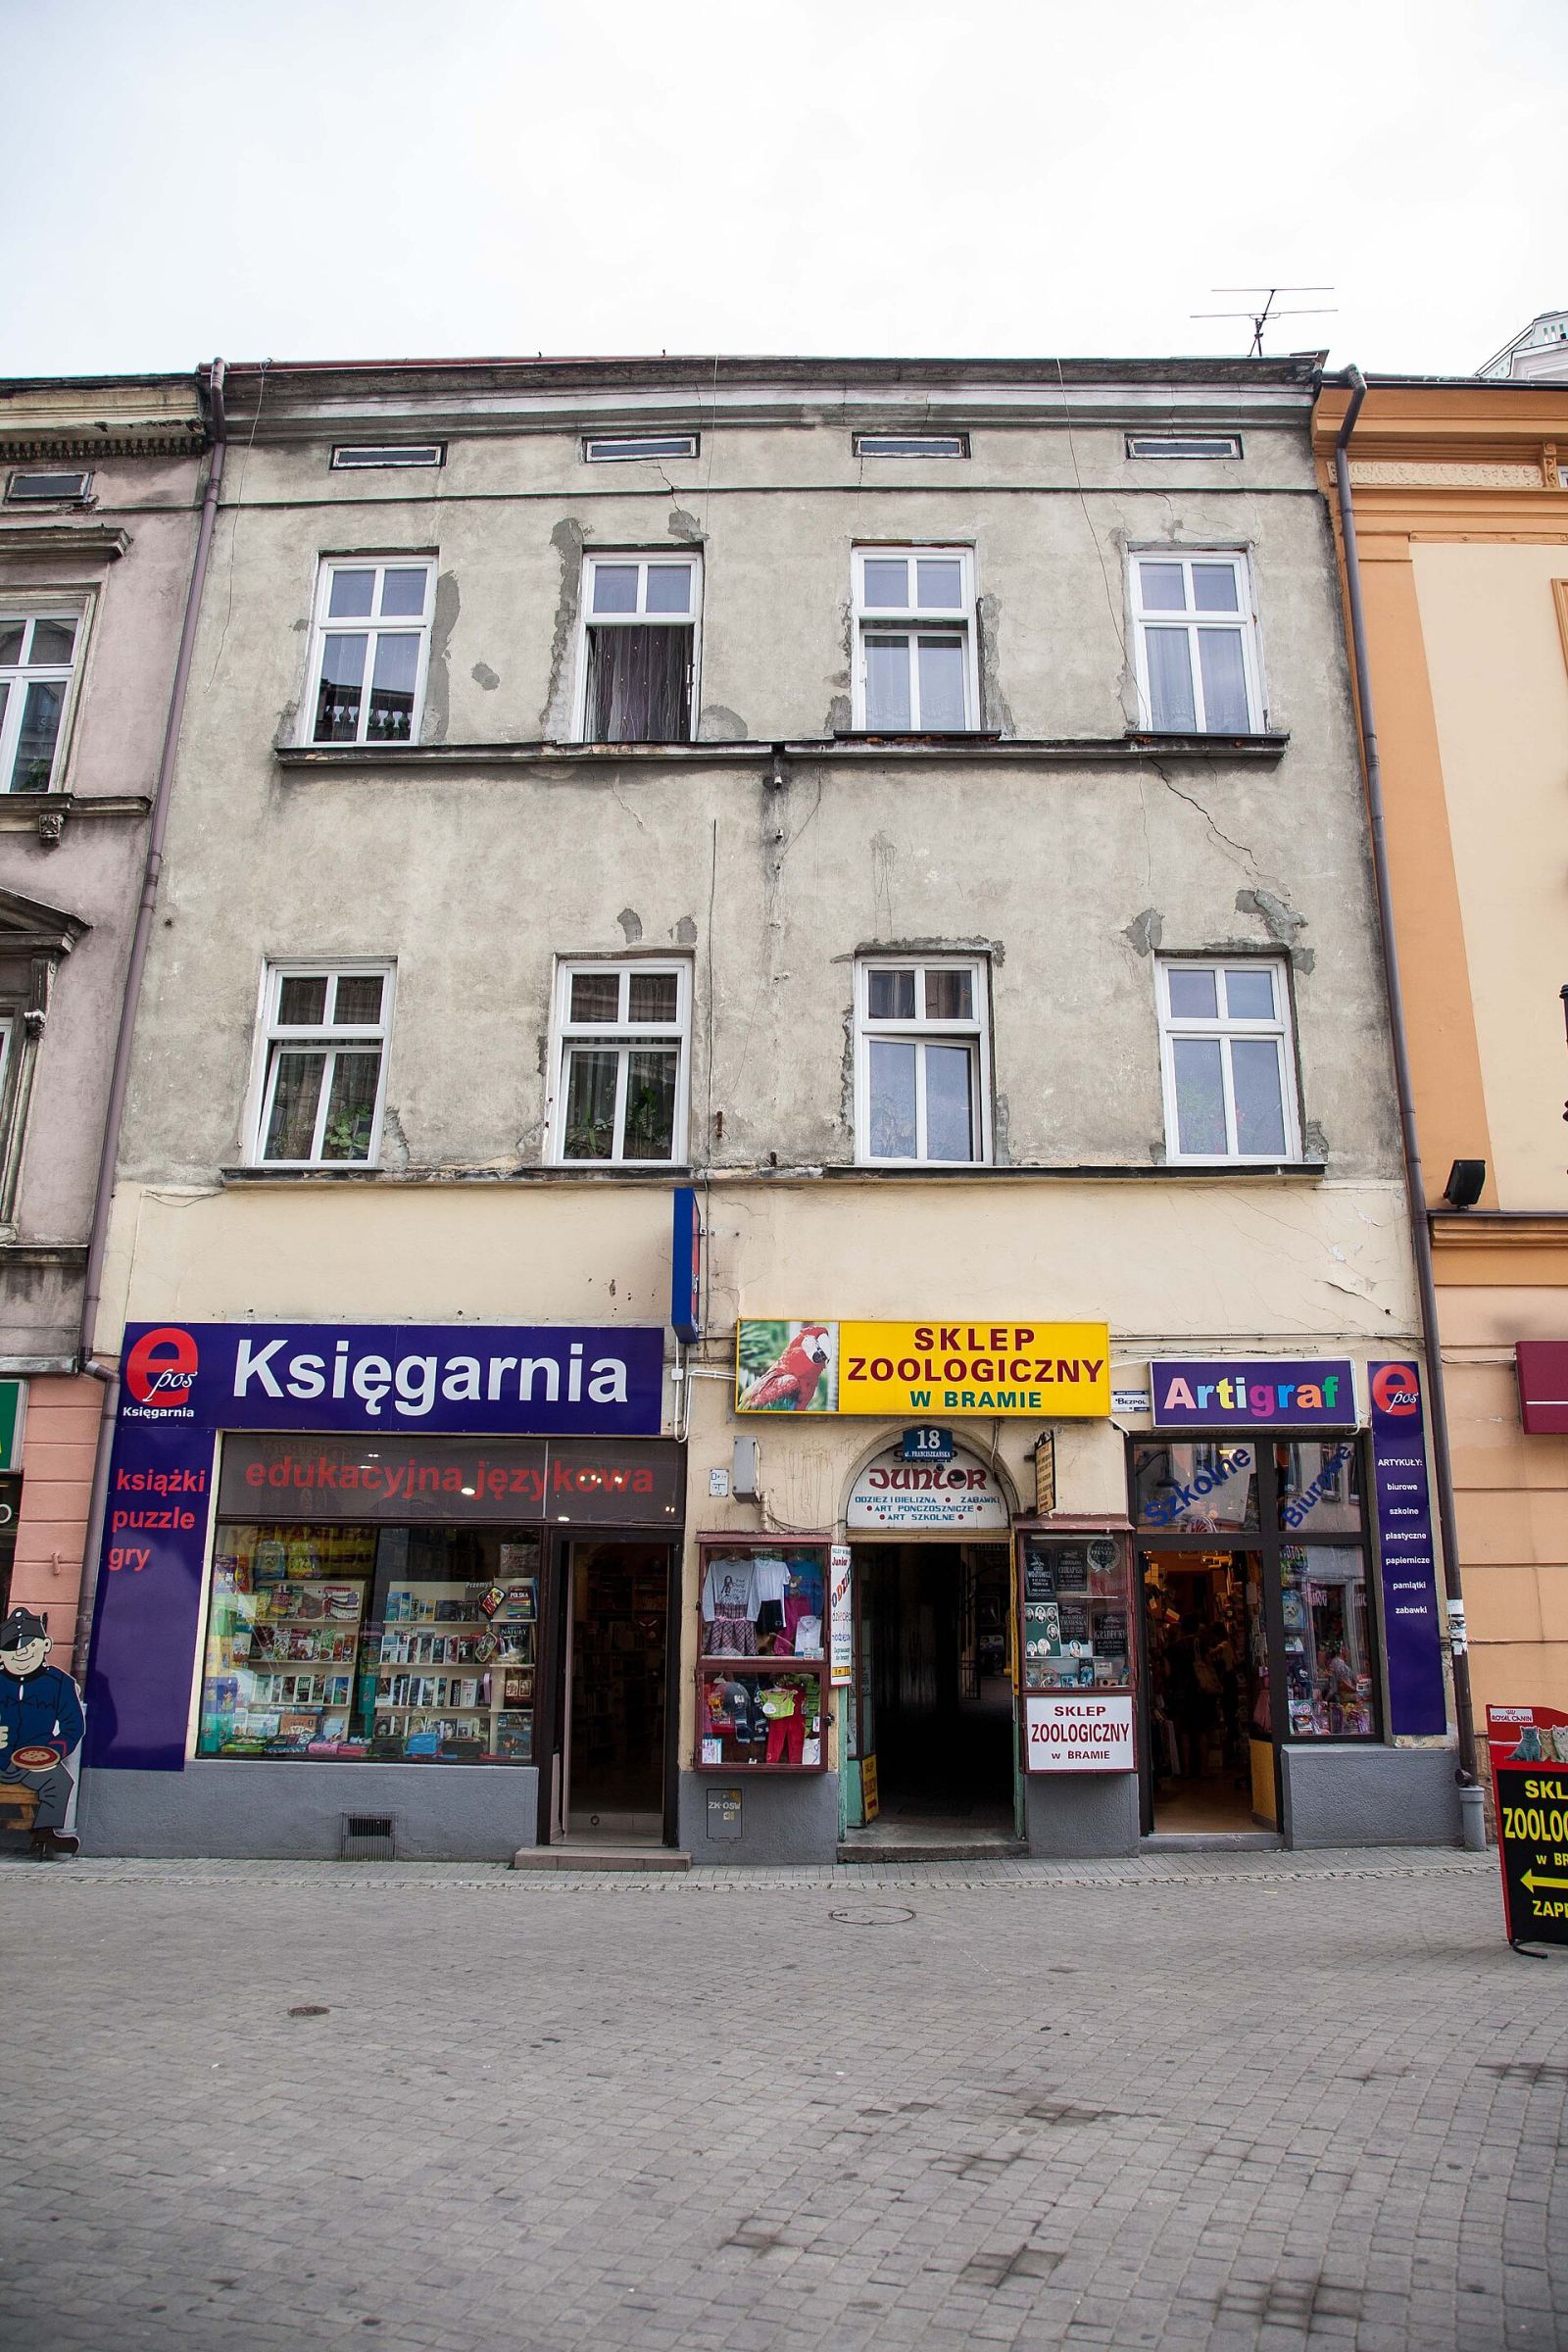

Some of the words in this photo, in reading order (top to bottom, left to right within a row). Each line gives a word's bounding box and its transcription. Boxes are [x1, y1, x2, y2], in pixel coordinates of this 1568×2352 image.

[913, 1327, 1036, 1351] SKLEP
[233, 1339, 628, 1416] Księgarnia
[847, 1357, 1104, 1383] ZOOLOGICZNY
[910, 1390, 932, 1407] W
[944, 1390, 1042, 1408] BRAMIE
[1163, 1376, 1340, 1417] Artigraf
[122, 1405, 195, 1419] Księgarnia
[917, 1429, 941, 1449] 18
[117, 1468, 206, 1497] książki
[246, 1456, 462, 1498] edukacyjna
[472, 1459, 654, 1501] językowa
[1144, 1447, 1251, 1527] Szkolne
[1282, 1445, 1351, 1529] Biurowe
[960, 1495, 1001, 1504] ZABAWKI
[112, 1506, 196, 1533] puzzle
[109, 1547, 151, 1572] gry
[1393, 1581, 1426, 1590] pamiątki
[1396, 1605, 1428, 1614] zabawki
[1054, 1706, 1106, 1717] SKLEP
[1031, 1723, 1130, 1742] ZOOLOGICZNY
[1067, 1750, 1110, 1760] BRAMIE
